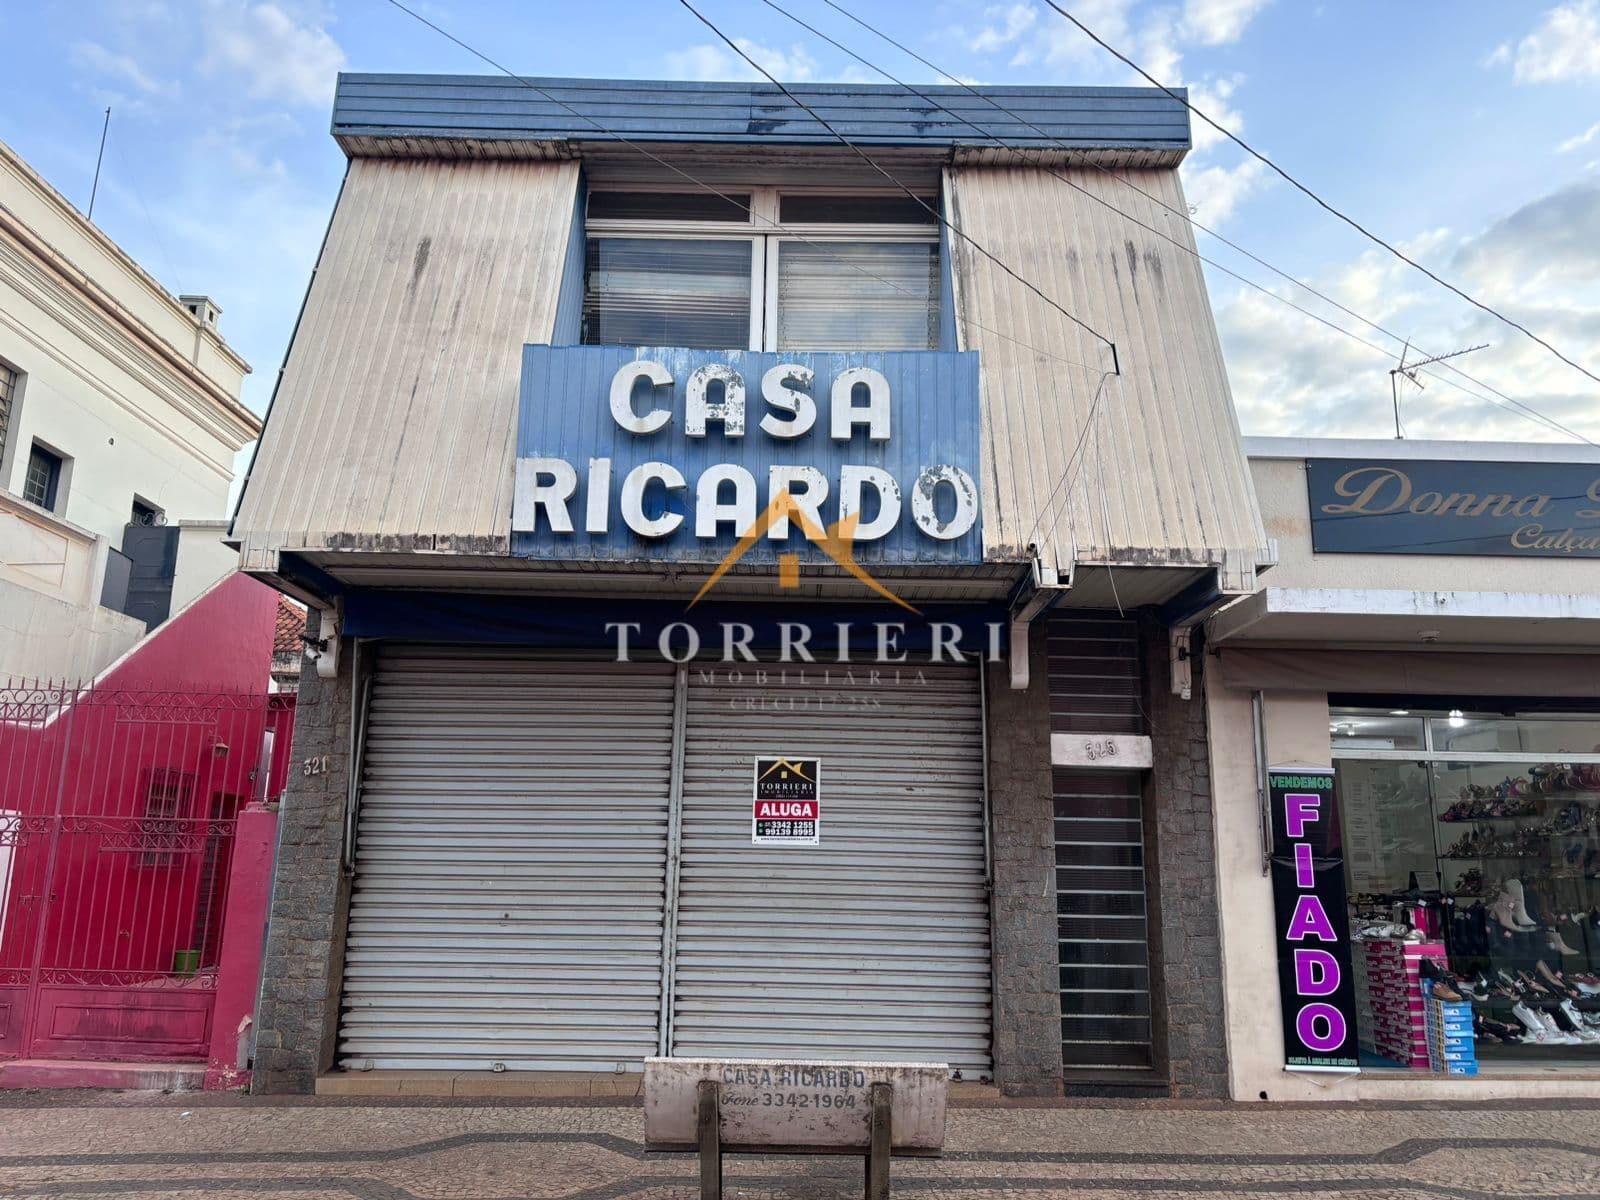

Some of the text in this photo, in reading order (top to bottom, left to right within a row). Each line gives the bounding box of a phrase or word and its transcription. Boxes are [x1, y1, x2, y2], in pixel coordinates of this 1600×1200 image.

[609, 360, 891, 440] CASA
[512, 457, 978, 541] RICARDO
[1320, 467, 1552, 517] Donna
[304, 755, 327, 776] 321
[1270, 776, 1333, 789] VENDEMOS
[760, 803, 812, 817] ALUGA
[771, 821, 791, 829] 3342
[793, 821, 814, 829] 1255
[1284, 794, 1346, 1052] FIADO
[723, 1068, 865, 1088] CASA RICARDO
